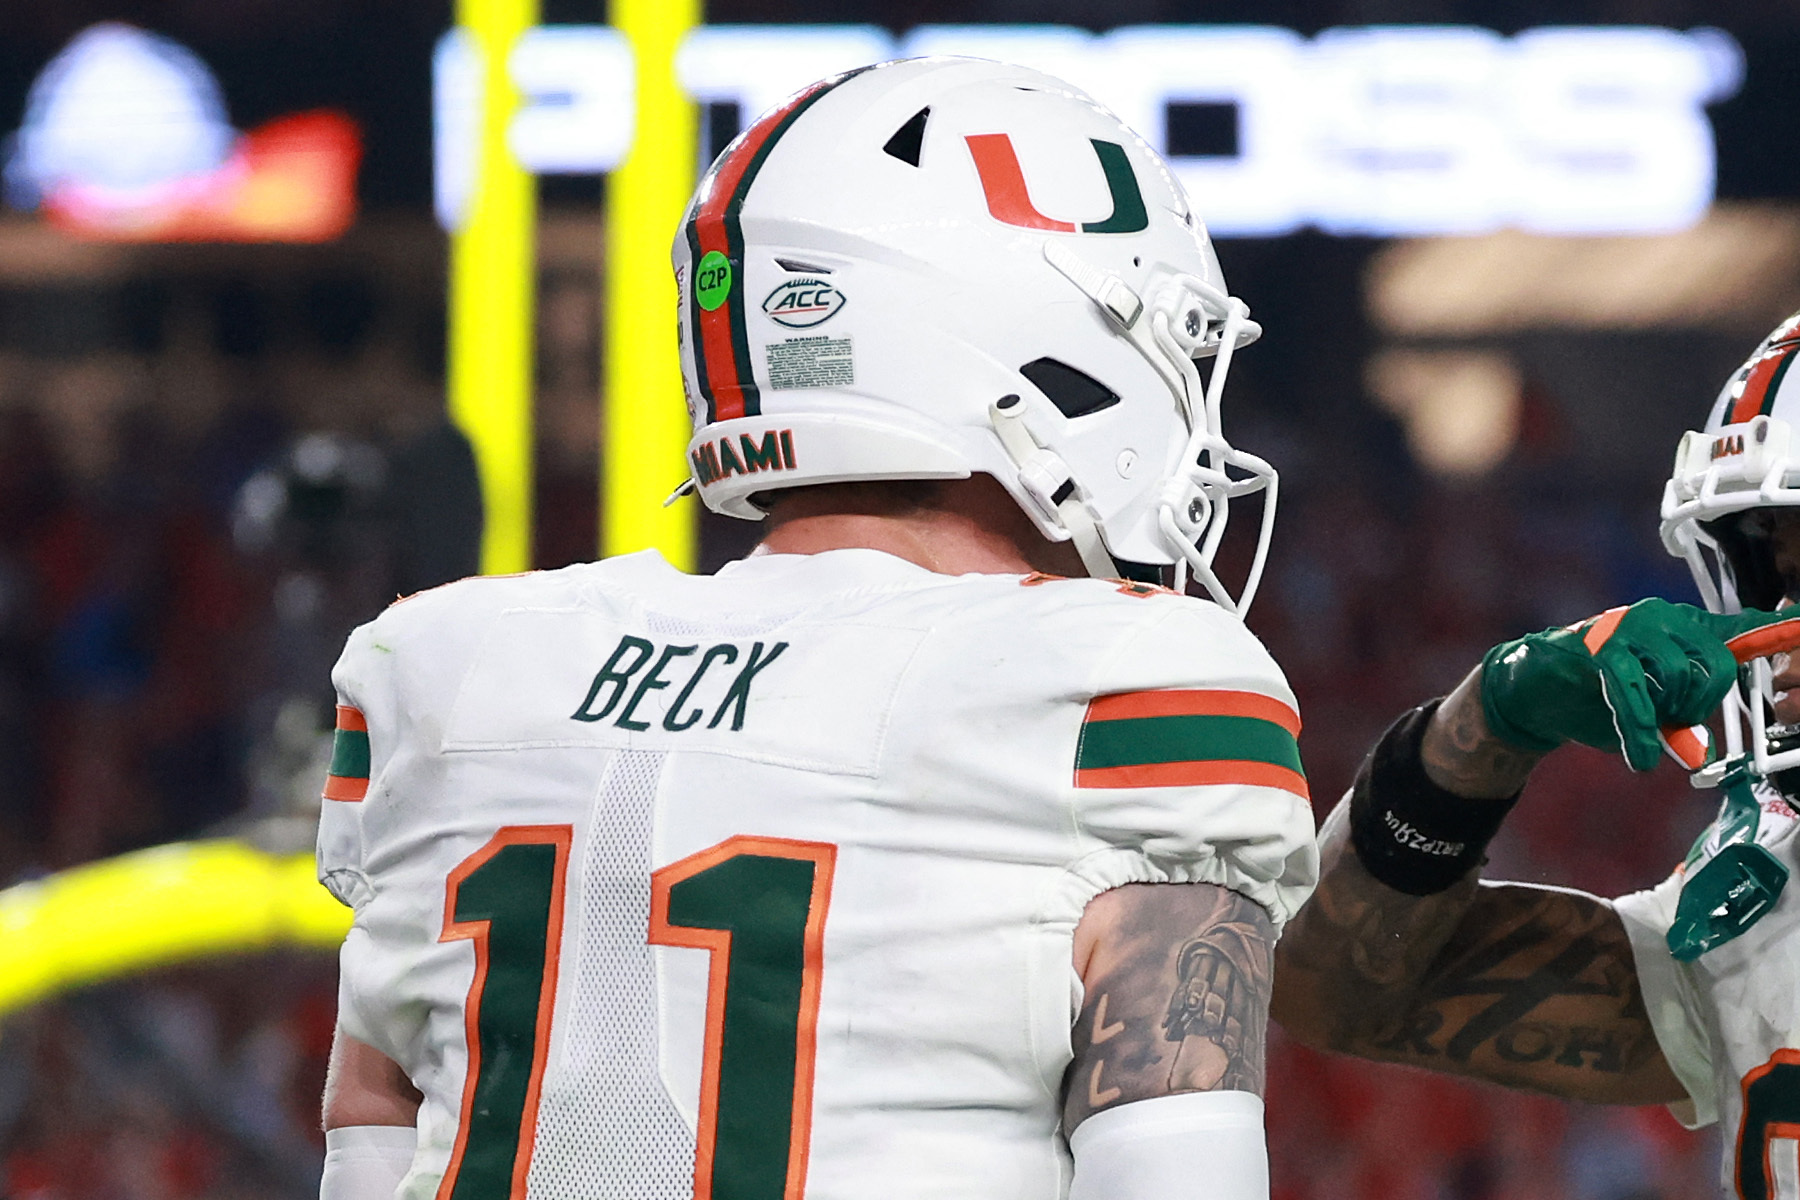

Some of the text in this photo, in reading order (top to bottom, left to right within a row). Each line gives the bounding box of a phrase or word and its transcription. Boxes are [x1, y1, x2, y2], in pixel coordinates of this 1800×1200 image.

[963, 132, 1149, 234] U
[699, 265, 727, 292] C2P
[773, 289, 834, 311] ACC
[785, 335, 829, 343] WARNING
[691, 428, 798, 487] MIAMI
[570, 634, 789, 732] BECK
